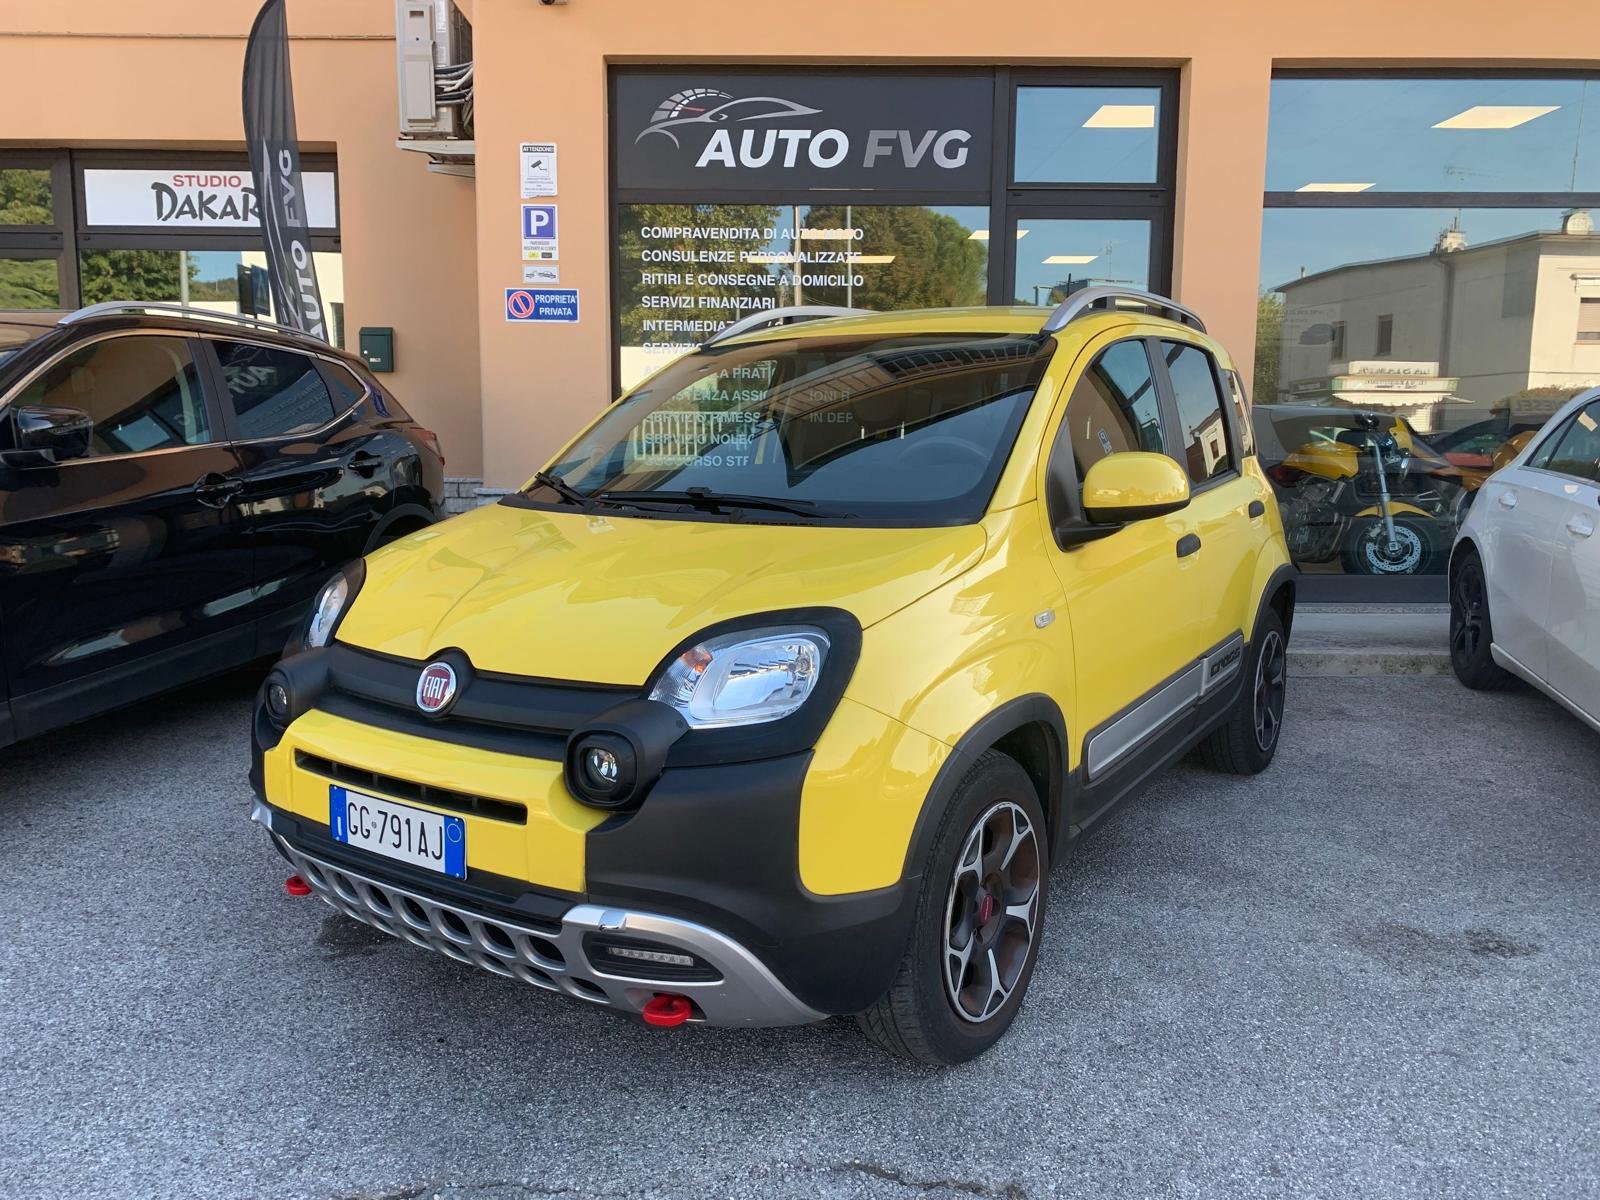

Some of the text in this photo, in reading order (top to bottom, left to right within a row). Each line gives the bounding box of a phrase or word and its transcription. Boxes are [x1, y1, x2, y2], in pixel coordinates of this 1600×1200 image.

[695, 129, 972, 169] AUTO FVG
[173, 174, 242, 188] STUDIO
[151, 182, 260, 222] DAKAR
[530, 210, 549, 235] P
[641, 226, 760, 240] COMPRAVENDITA
[763, 228, 777, 239] DI
[781, 228, 818, 240] AU
[279, 149, 325, 341] AUTO FVG
[641, 250, 862, 264] CONSULENZE PERSONALIZZATE
[641, 273, 864, 287] RITIRI E CONSEGNE A DOMICILIO
[641, 296, 776, 309] SERVIZI FINANZIARI
[539, 307, 573, 316] PRIVATA
[643, 320, 734, 332] INTERMEDIA
[423, 676, 448, 700] FIAT
[378, 810, 443, 860] 791AJ
